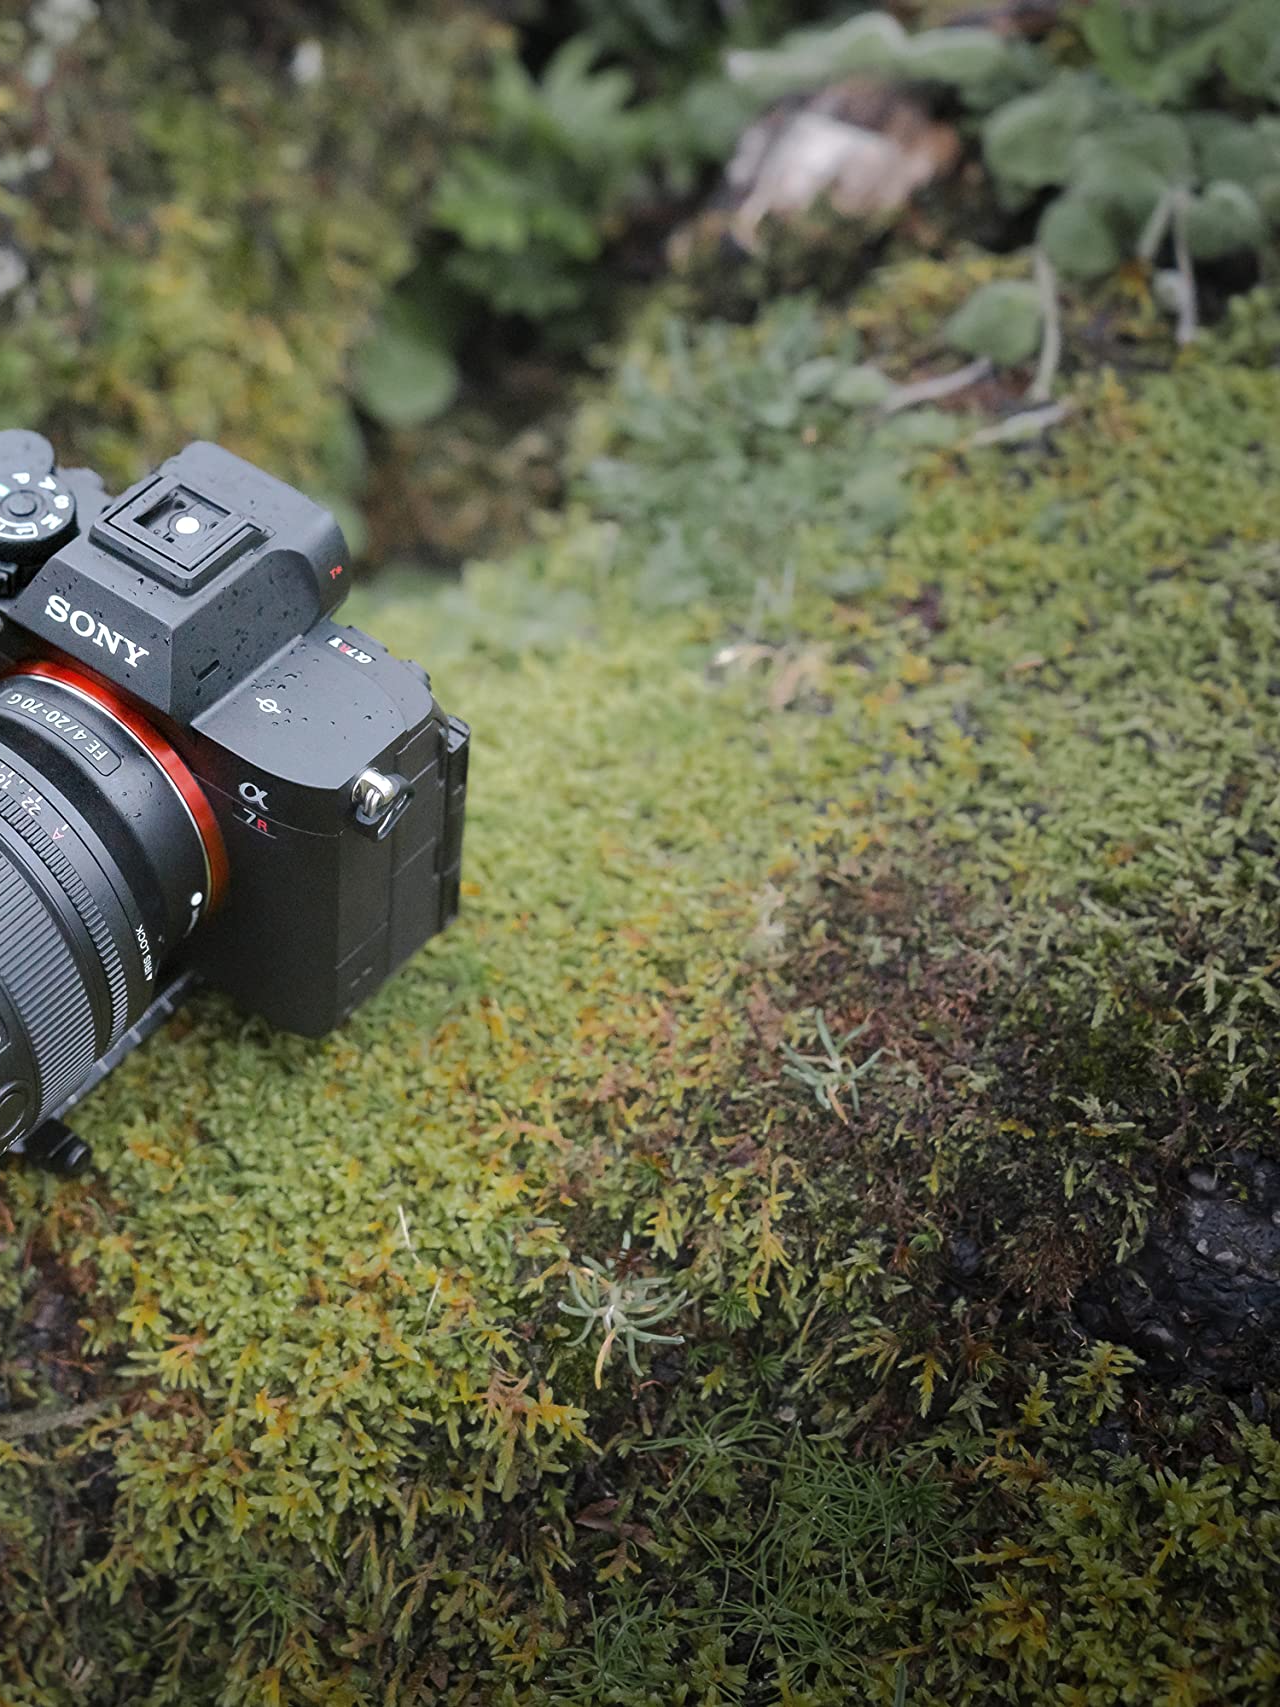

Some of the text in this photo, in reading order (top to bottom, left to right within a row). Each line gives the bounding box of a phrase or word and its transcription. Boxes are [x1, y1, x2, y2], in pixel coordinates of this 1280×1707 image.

[45, 594, 150, 668] SONY
[6, 693, 23, 706] G
[84, 738, 109, 761] FE
[21, 796, 42, 816] 22
[243, 807, 269, 833] 7R
[52, 827, 65, 840] A
[135, 923, 150, 956] LOCK
